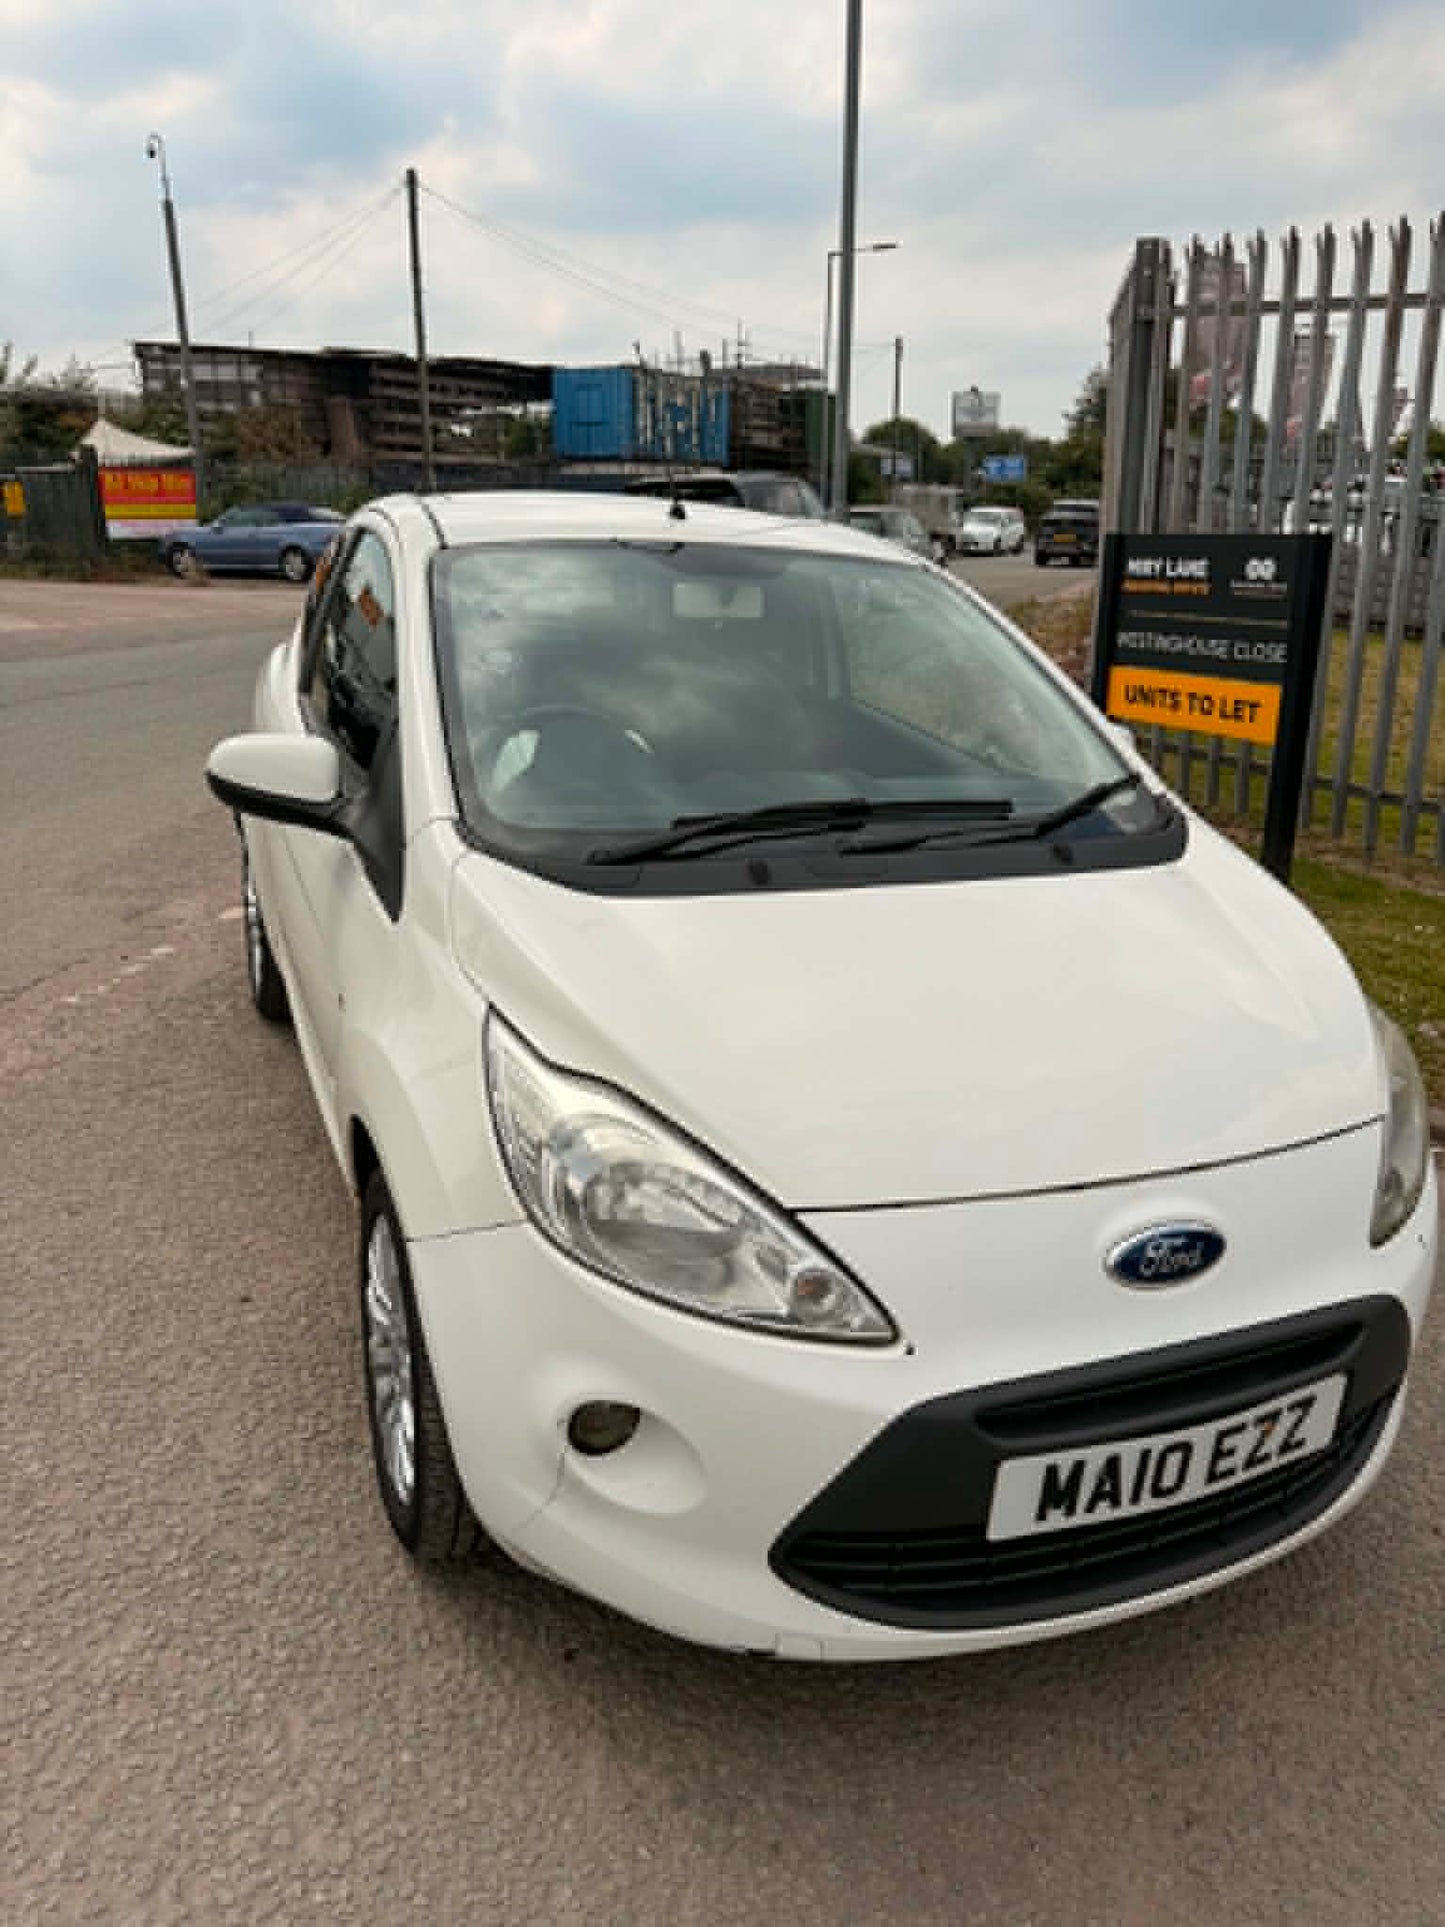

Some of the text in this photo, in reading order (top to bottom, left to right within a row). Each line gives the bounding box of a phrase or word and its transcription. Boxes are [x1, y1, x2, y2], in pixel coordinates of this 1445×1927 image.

[1124, 684, 1261, 723] UNITS TO LET
[1139, 1235, 1203, 1277] Ford
[1035, 1395, 1317, 1521] MA10 EZZ
